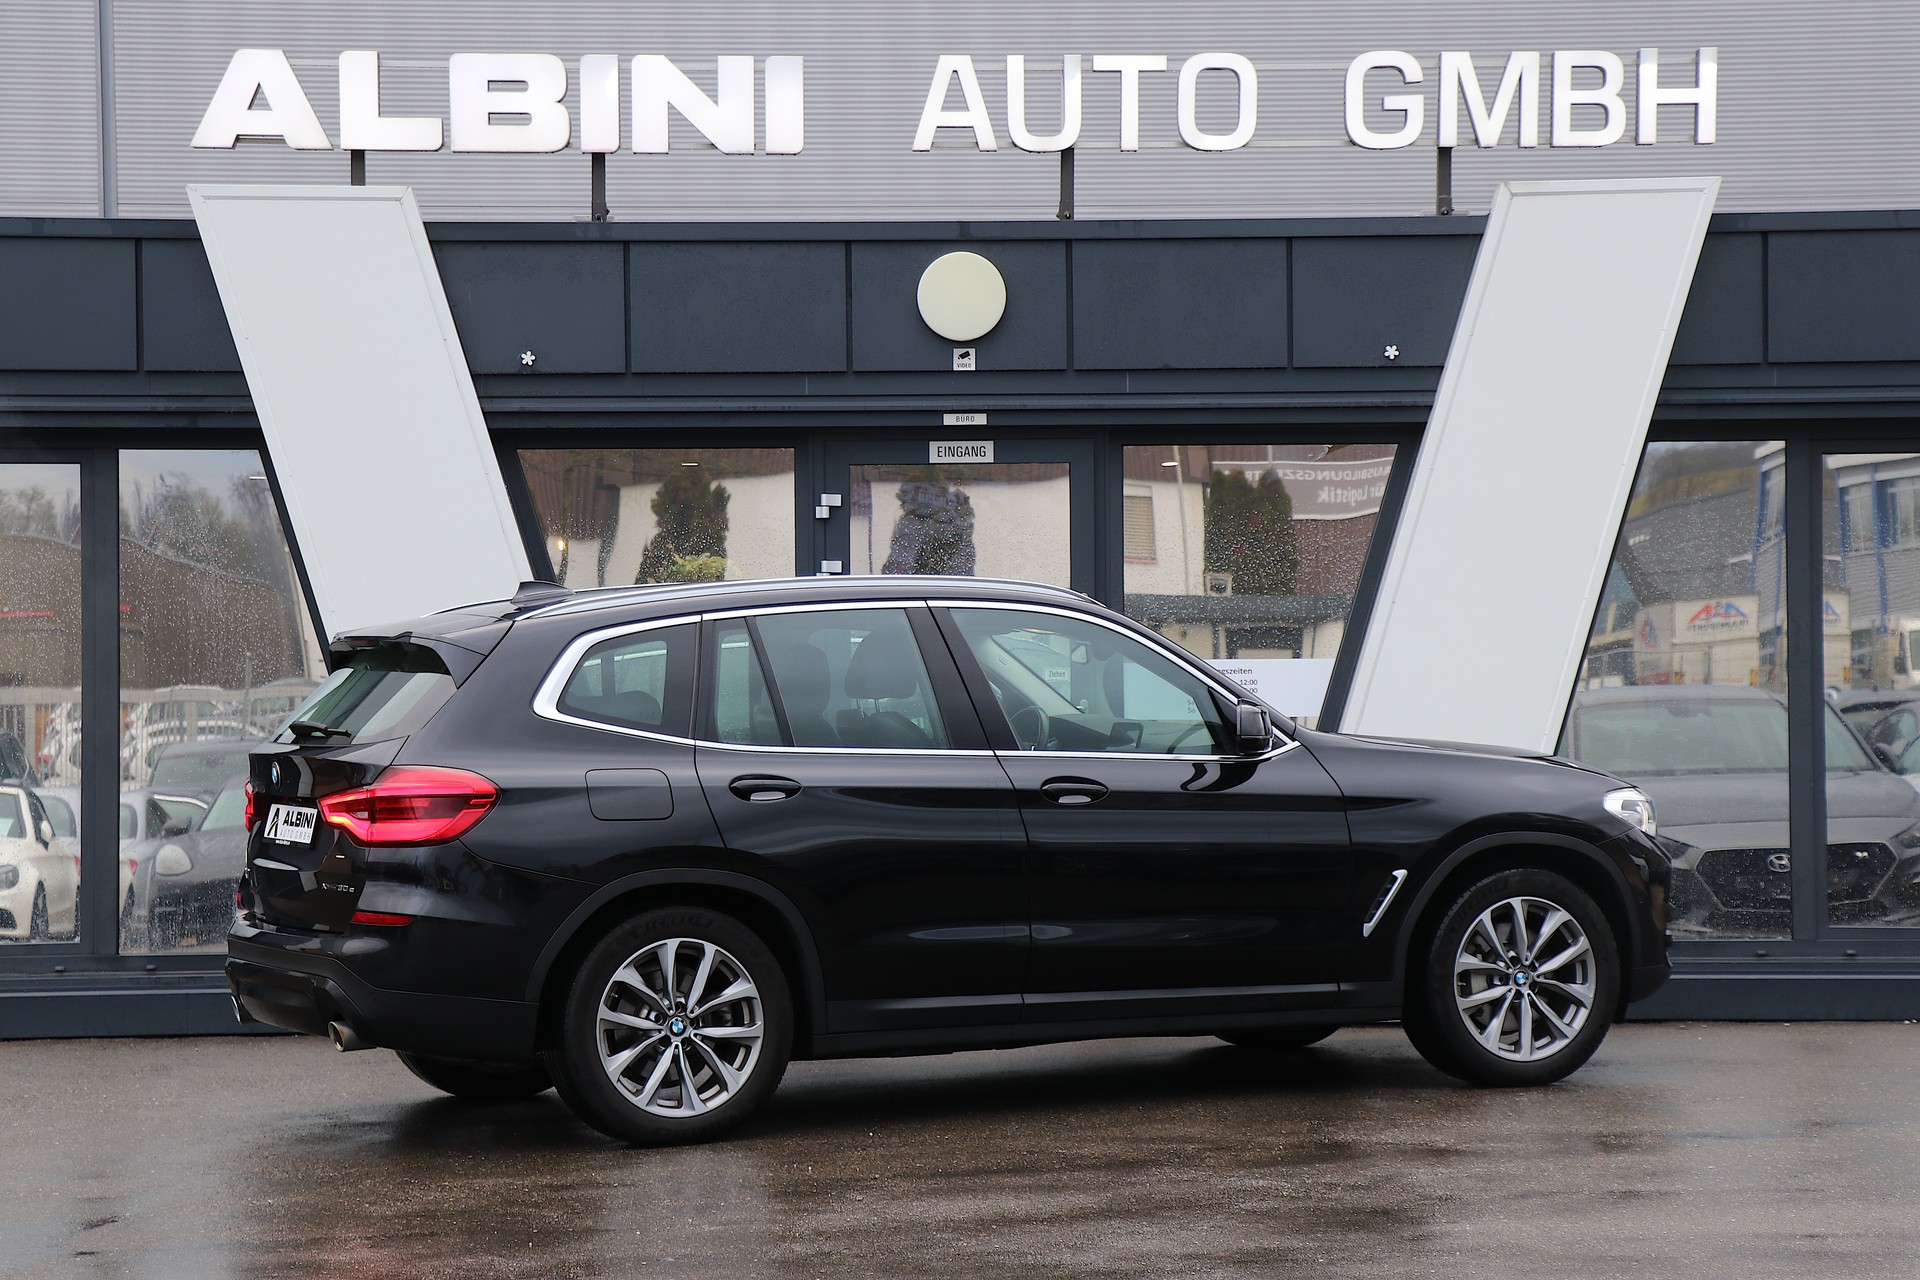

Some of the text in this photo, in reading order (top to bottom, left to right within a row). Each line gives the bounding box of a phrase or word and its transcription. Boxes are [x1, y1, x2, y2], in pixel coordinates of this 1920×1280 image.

[190, 46, 1718, 155] ALBINI AUTO GMBH
[937, 445, 987, 458] EINGANG
[282, 810, 315, 829] ALBINI
